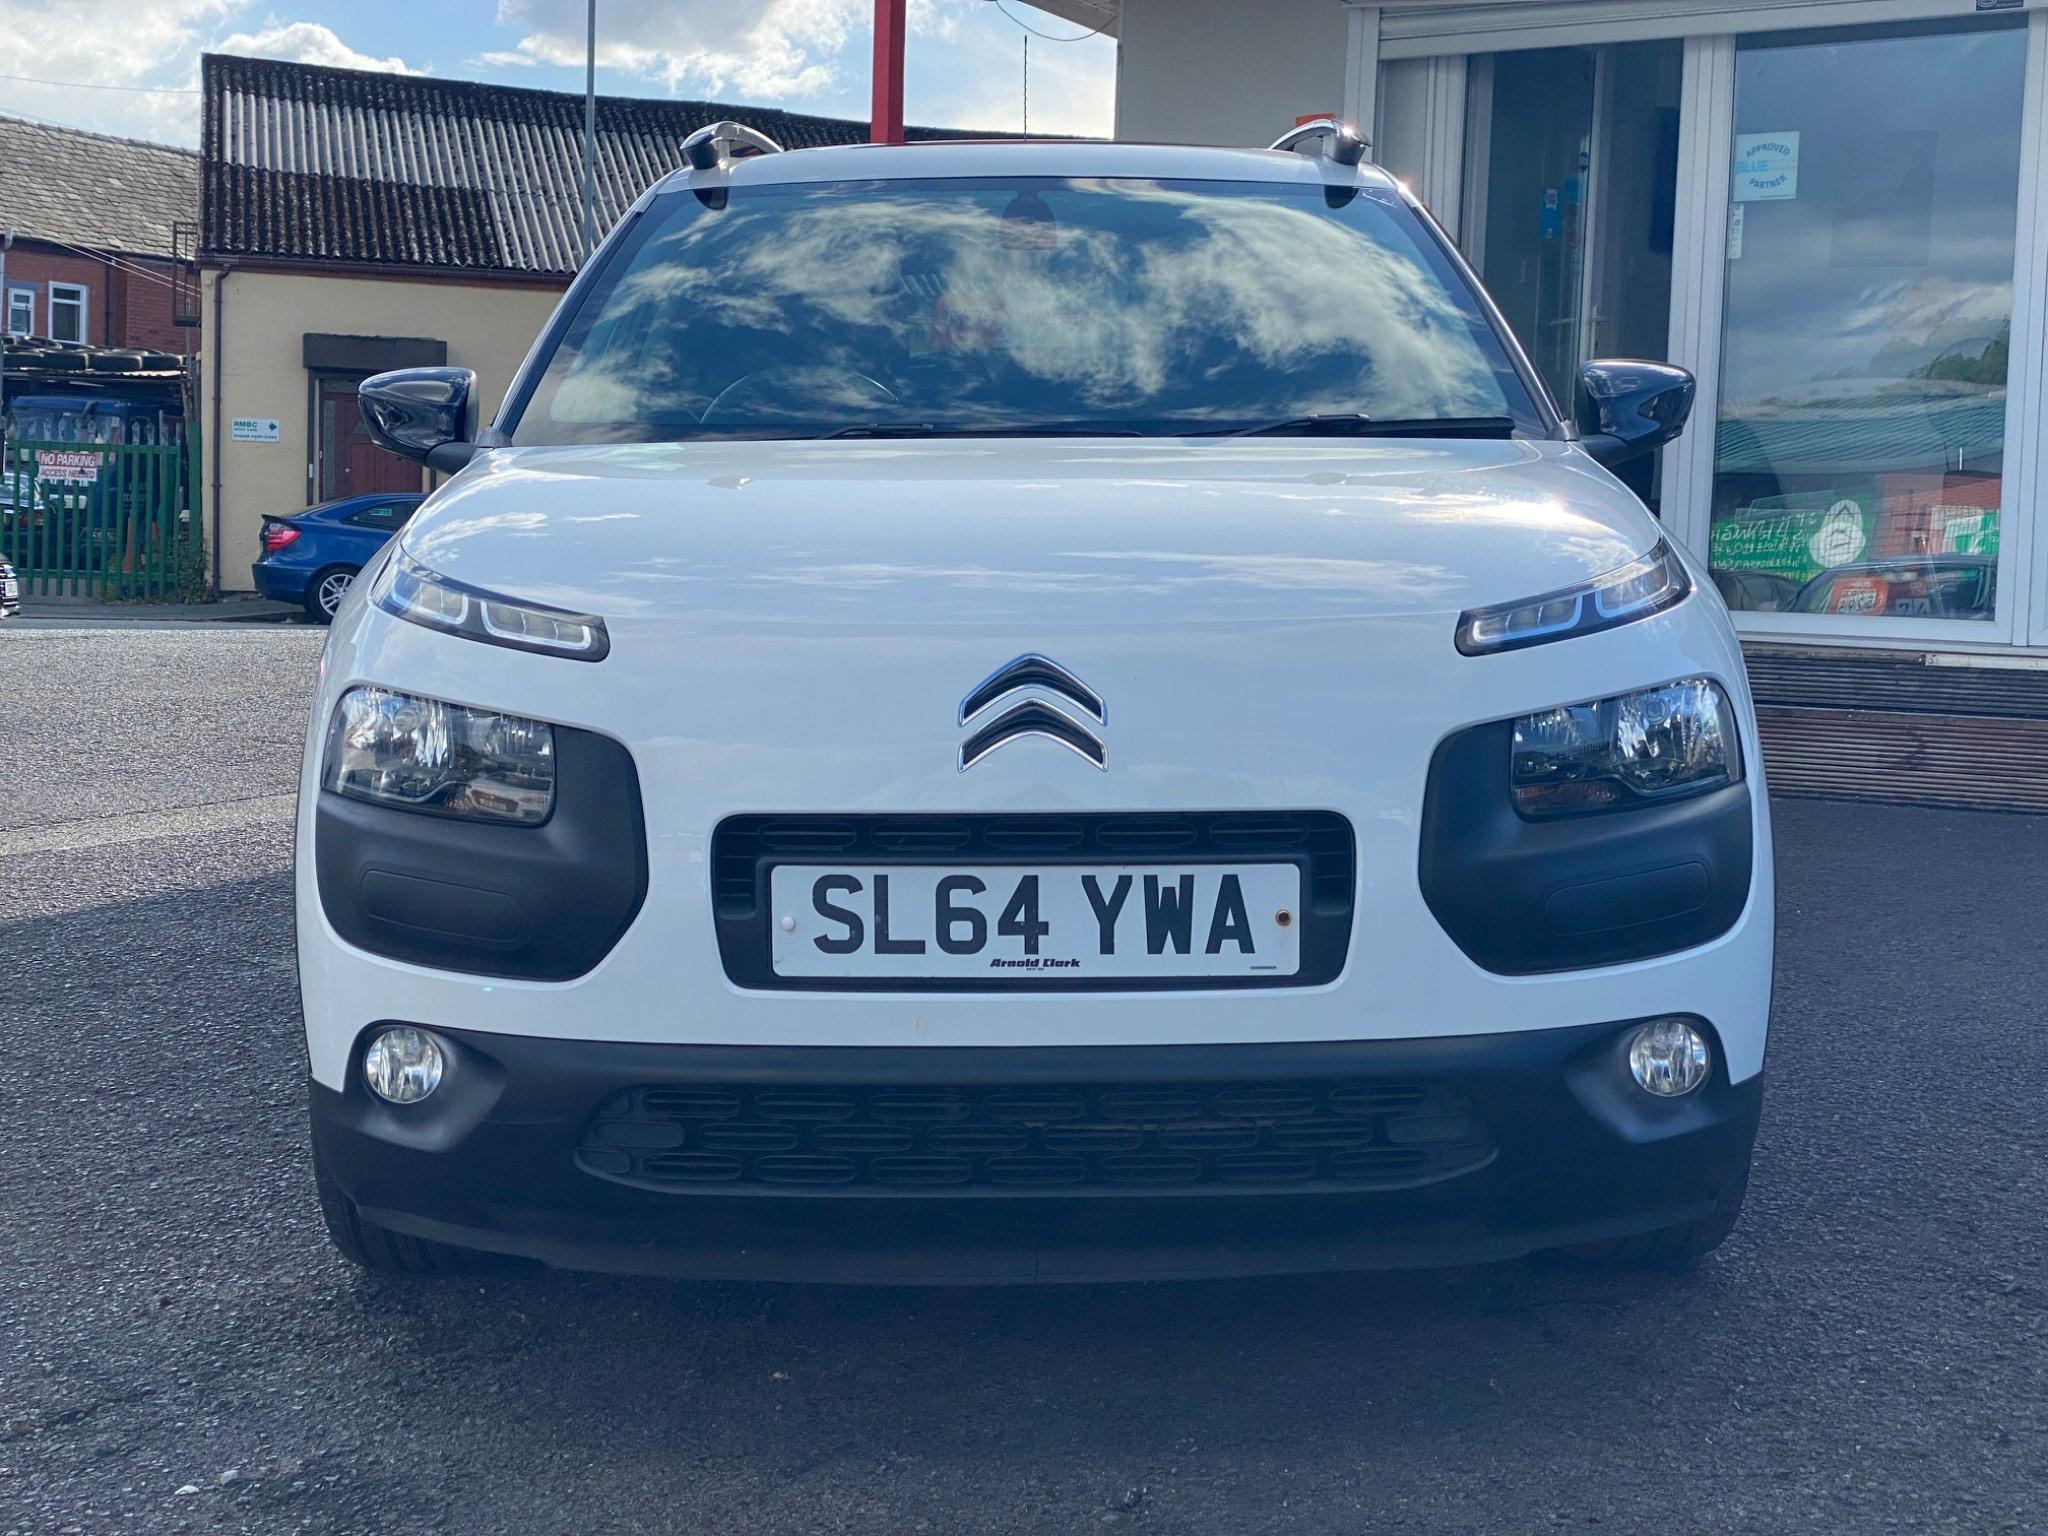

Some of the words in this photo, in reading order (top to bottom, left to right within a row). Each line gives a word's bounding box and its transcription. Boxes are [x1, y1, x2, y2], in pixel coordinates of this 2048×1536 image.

[1746, 143, 1791, 158] APPROVED
[1736, 160, 1769, 174] BLUE
[1749, 175, 1786, 189] PARTNER
[41, 453, 55, 465] NO
[57, 454, 95, 467] PARKING
[42, 469, 67, 477] ACCESS
[812, 874, 1049, 955] SL64
[1081, 874, 1256, 955] YWA
[990, 959, 1040, 967] Arnold
[1043, 959, 1080, 967] Clark
